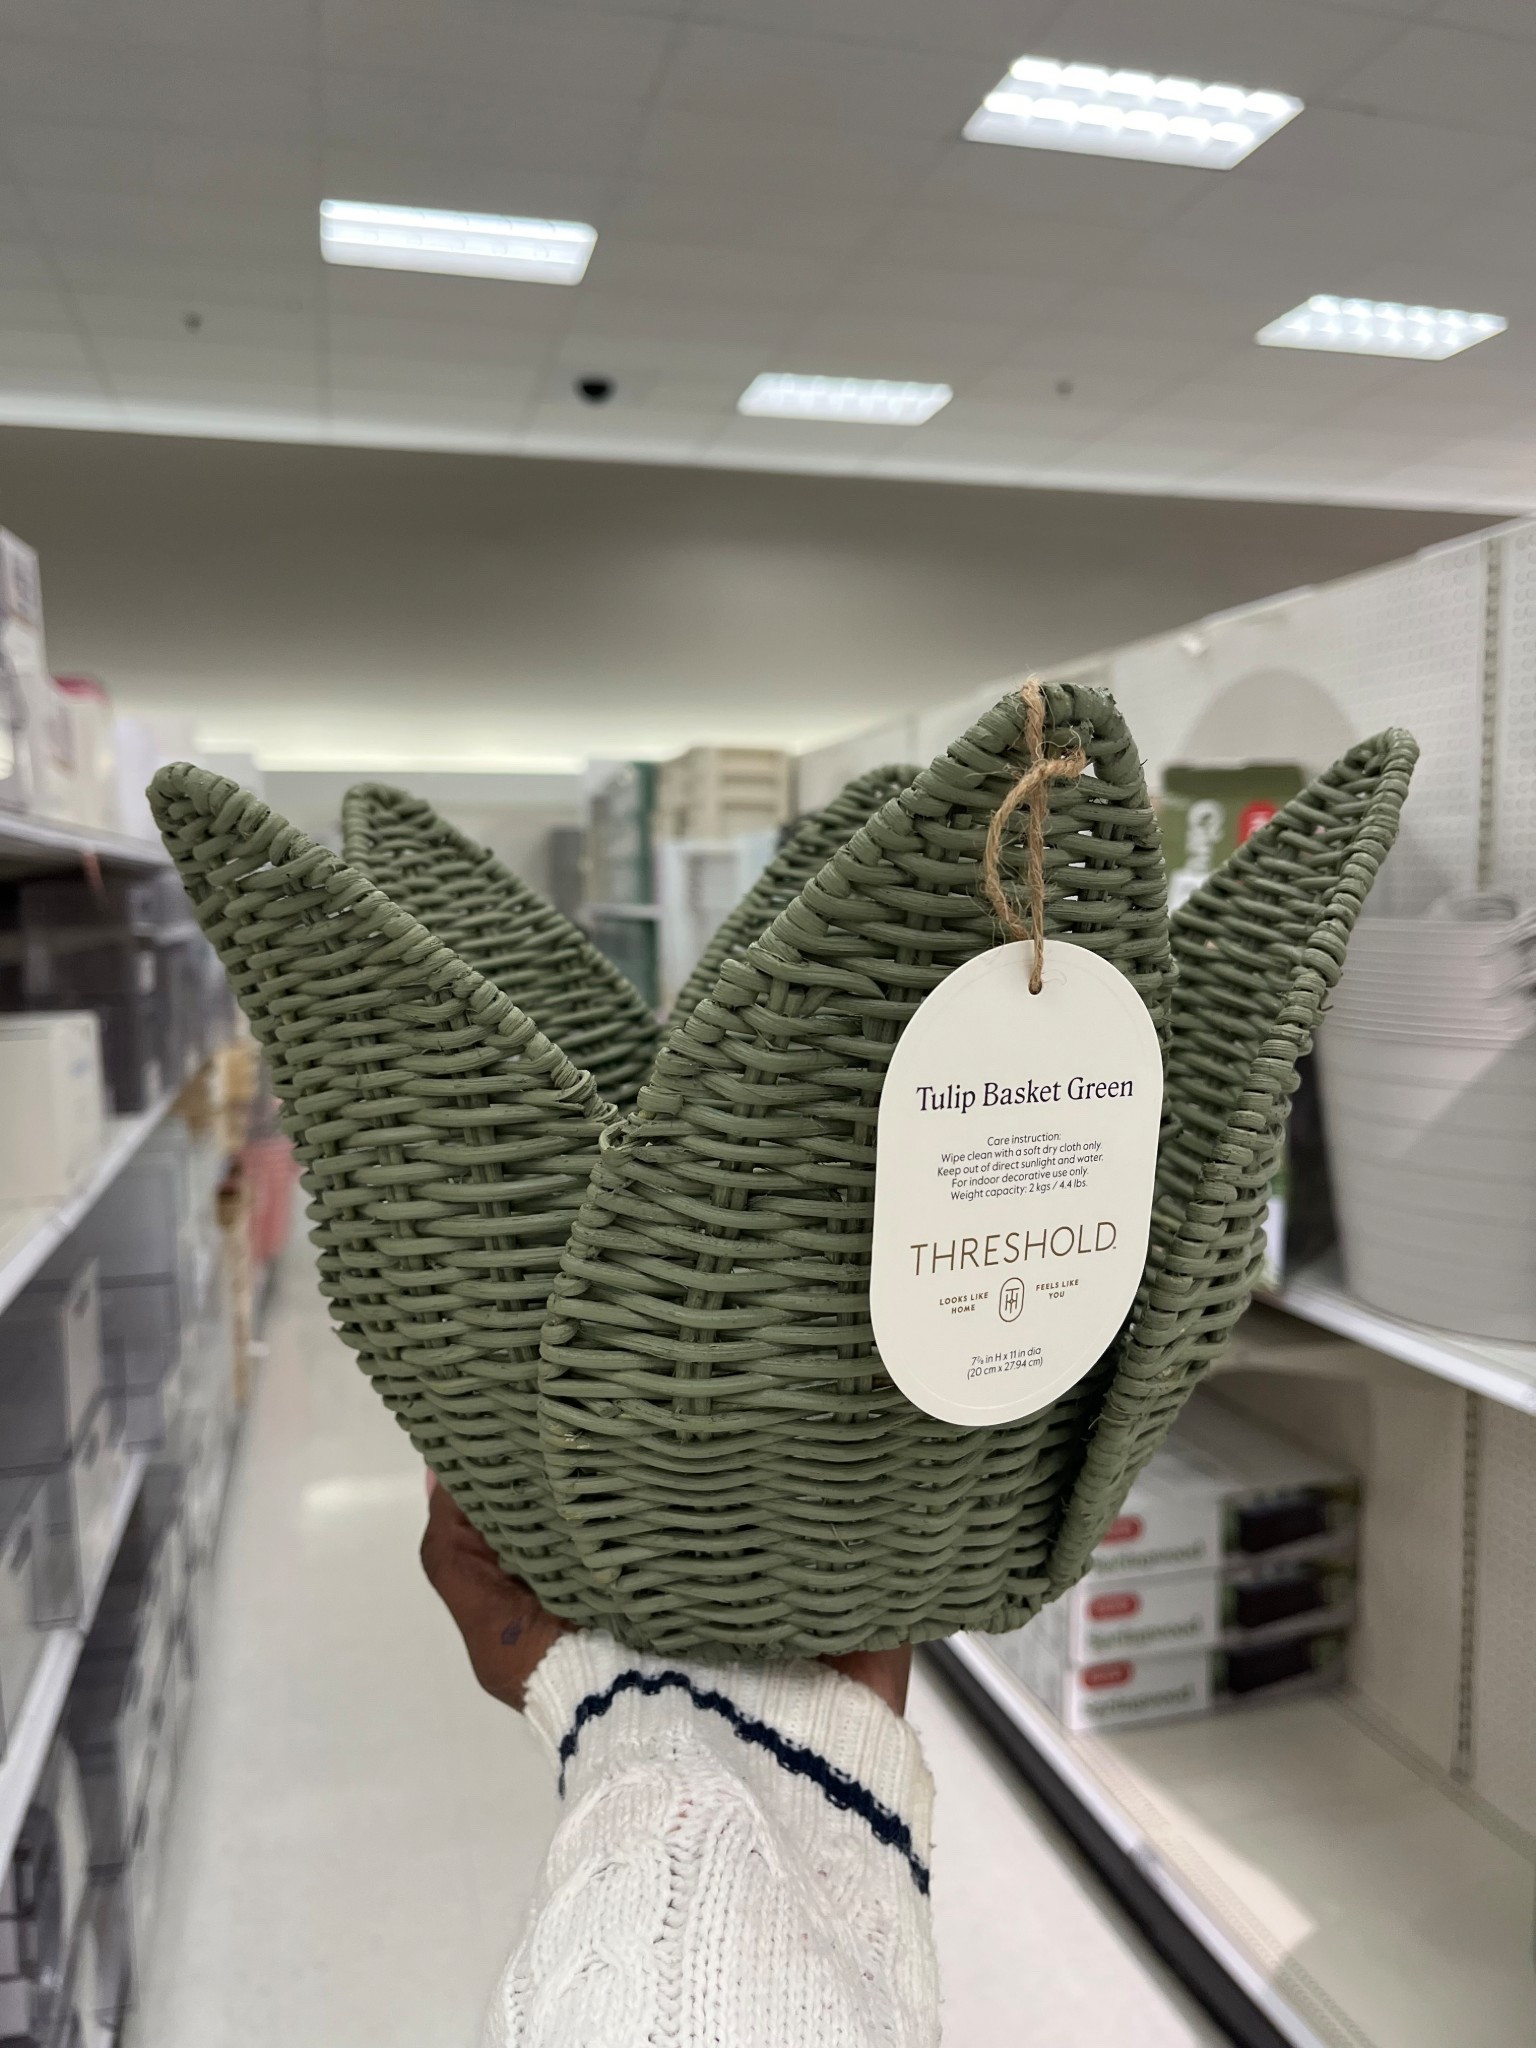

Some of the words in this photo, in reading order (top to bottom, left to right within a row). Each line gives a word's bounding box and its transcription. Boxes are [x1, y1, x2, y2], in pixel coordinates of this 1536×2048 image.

[916, 1084, 976, 1114] Tulip
[982, 1079, 1062, 1107] Basket
[1067, 1076, 1134, 1100] Green
[987, 1136, 1010, 1146] Care
[1011, 1132, 1062, 1144] instruction:
[941, 1153, 966, 1164] Wipe
[967, 1150, 993, 1160] clean
[994, 1147, 1014, 1157] with
[1023, 1145, 1041, 1155] soft
[1042, 1144, 1058, 1155] dry
[1059, 1141, 1082, 1152] cloth
[1082, 1140, 1103, 1151] only.
[937, 1166, 962, 1177] Keep
[963, 1165, 979, 1173] out
[980, 1162, 991, 1172] of
[992, 1161, 1019, 1171] direct
[1021, 1156, 1056, 1169] sunlight
[1057, 1154, 1076, 1164] and
[1077, 1153, 1104, 1162] water.
[951, 1178, 969, 1187] For
[969, 1175, 1000, 1186] indoor
[1001, 1170, 1051, 1182] decorative
[1052, 1169, 1068, 1177] use
[1069, 1165, 1089, 1177] only.
[951, 1188, 984, 1201] Weight
[985, 1184, 1028, 1197] capacity:
[1029, 1182, 1035, 1192] 2
[1036, 1182, 1051, 1193] kgs
[1059, 1180, 1072, 1189] 4.4
[1073, 1178, 1089, 1188] lbs.
[910, 1221, 1117, 1276] THRESHOLD
[1035, 1281, 1060, 1291] FEELS
[1061, 1278, 1080, 1288] LIKE
[1048, 1290, 1066, 1299] YOU
[939, 1294, 969, 1306] LOOKS
[970, 1291, 989, 1301] LIKE
[951, 1303, 976, 1314] HOME
[985, 1354, 994, 1363] in
[994, 1352, 1002, 1361] H
[1010, 1350, 1017, 1358] 11
[1017, 1348, 1026, 1357] in
[1027, 1346, 1042, 1355] dia
[967, 1366, 983, 1380] (20
[983, 1366, 997, 1374] cm
[1004, 1359, 1027, 1371] 27.94
[1028, 1356, 1044, 1366] cm)
